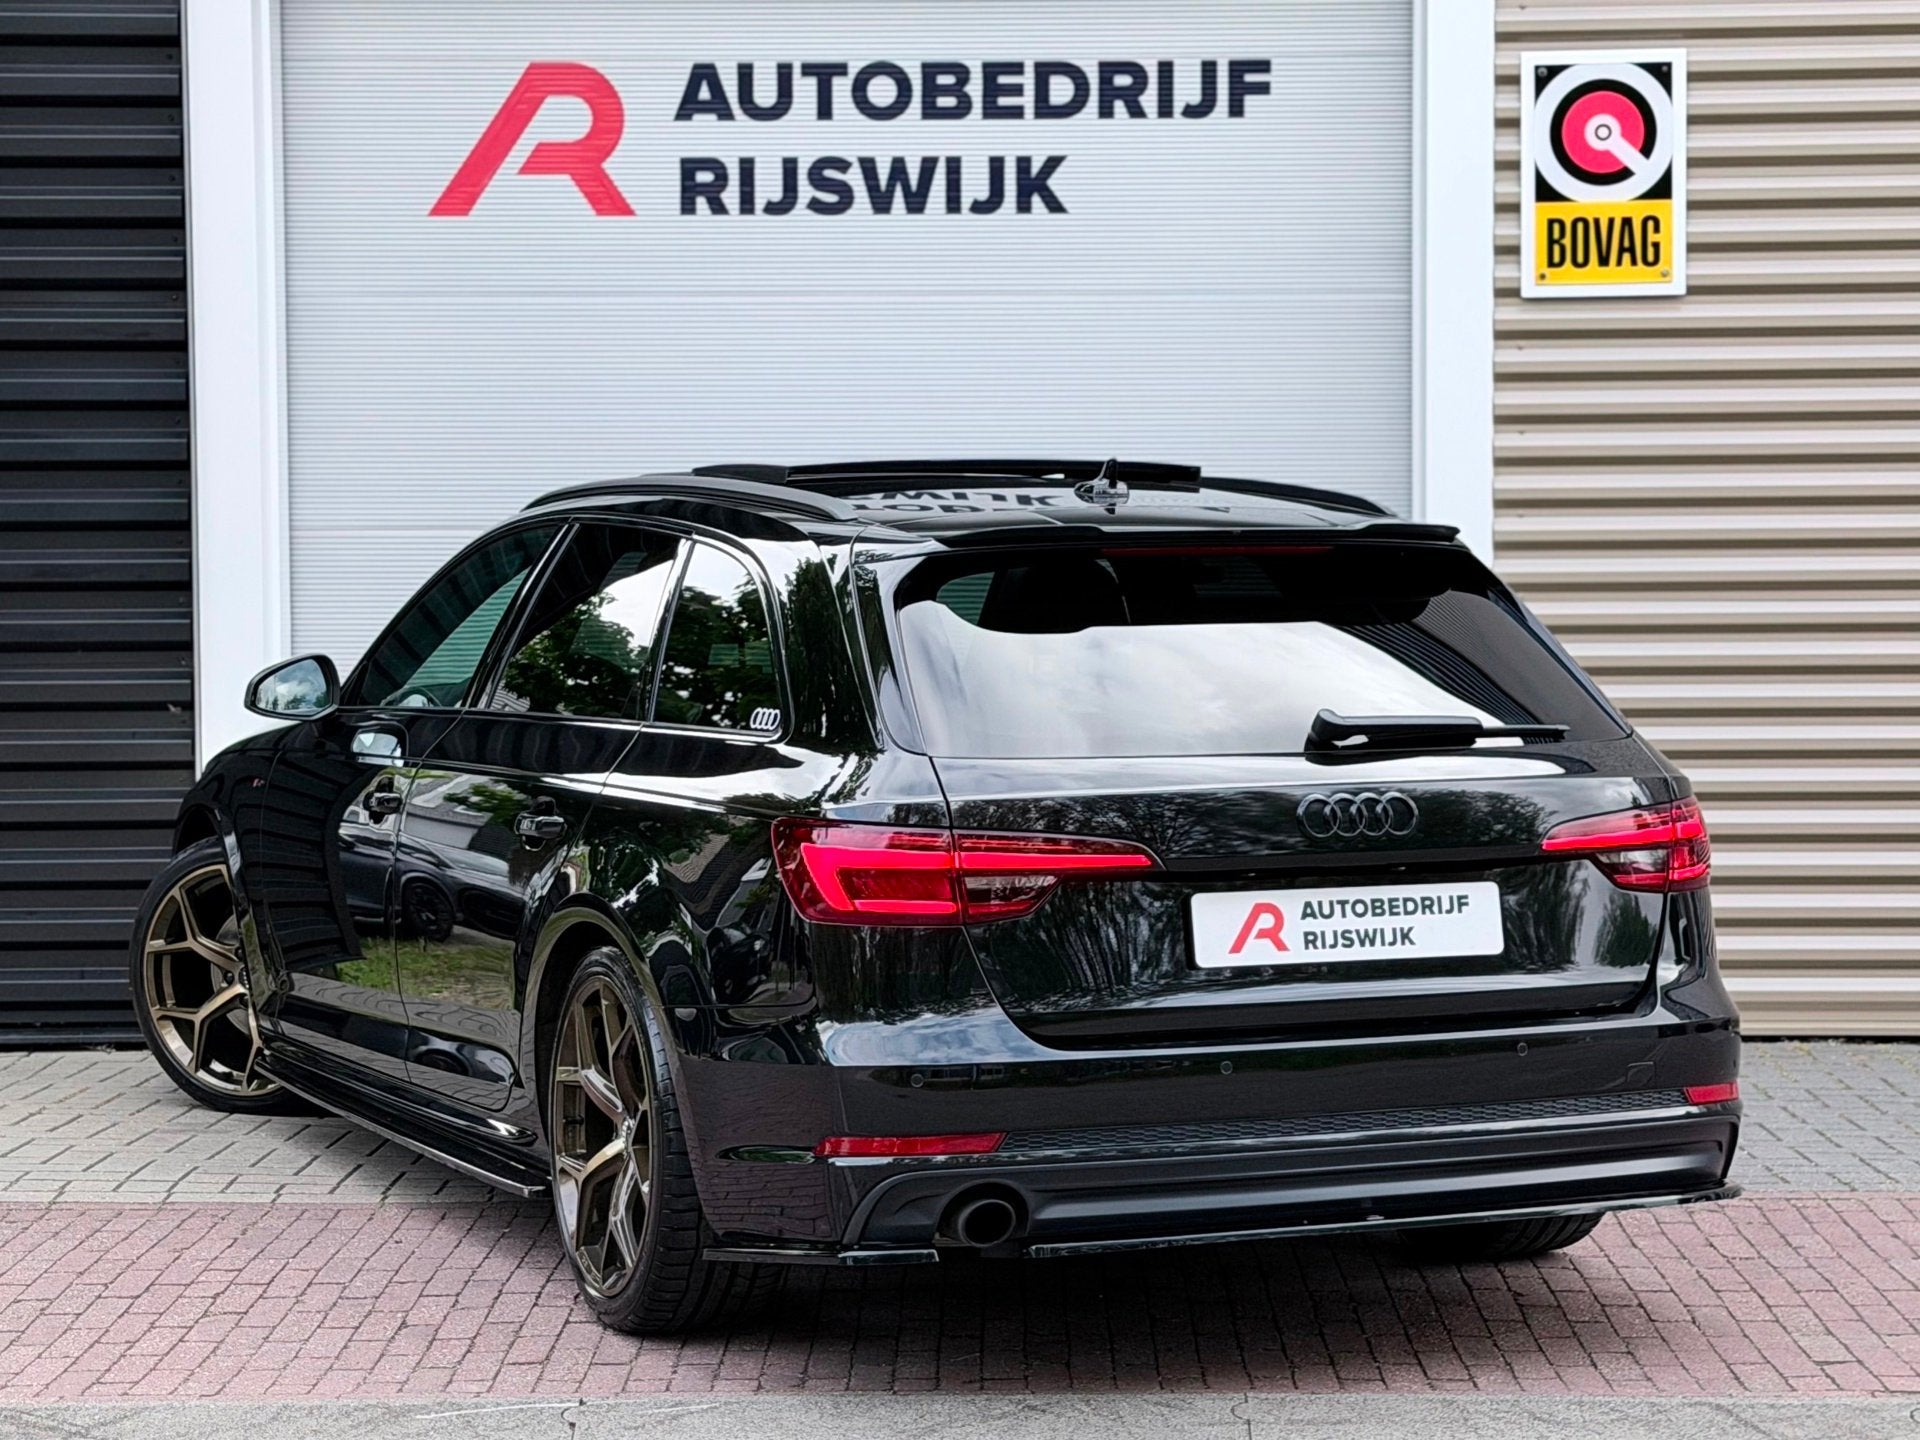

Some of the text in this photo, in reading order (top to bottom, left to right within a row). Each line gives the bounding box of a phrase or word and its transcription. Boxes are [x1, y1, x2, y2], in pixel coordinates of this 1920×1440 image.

[673, 59, 1272, 122] AUTOBEDRIJF
[679, 155, 1068, 216] RIJSWIJK
[1546, 214, 1661, 269] BOVAG
[1300, 894, 1470, 921] AUTOBEDRIJF
[1303, 926, 1417, 951] RIJSWIJK
